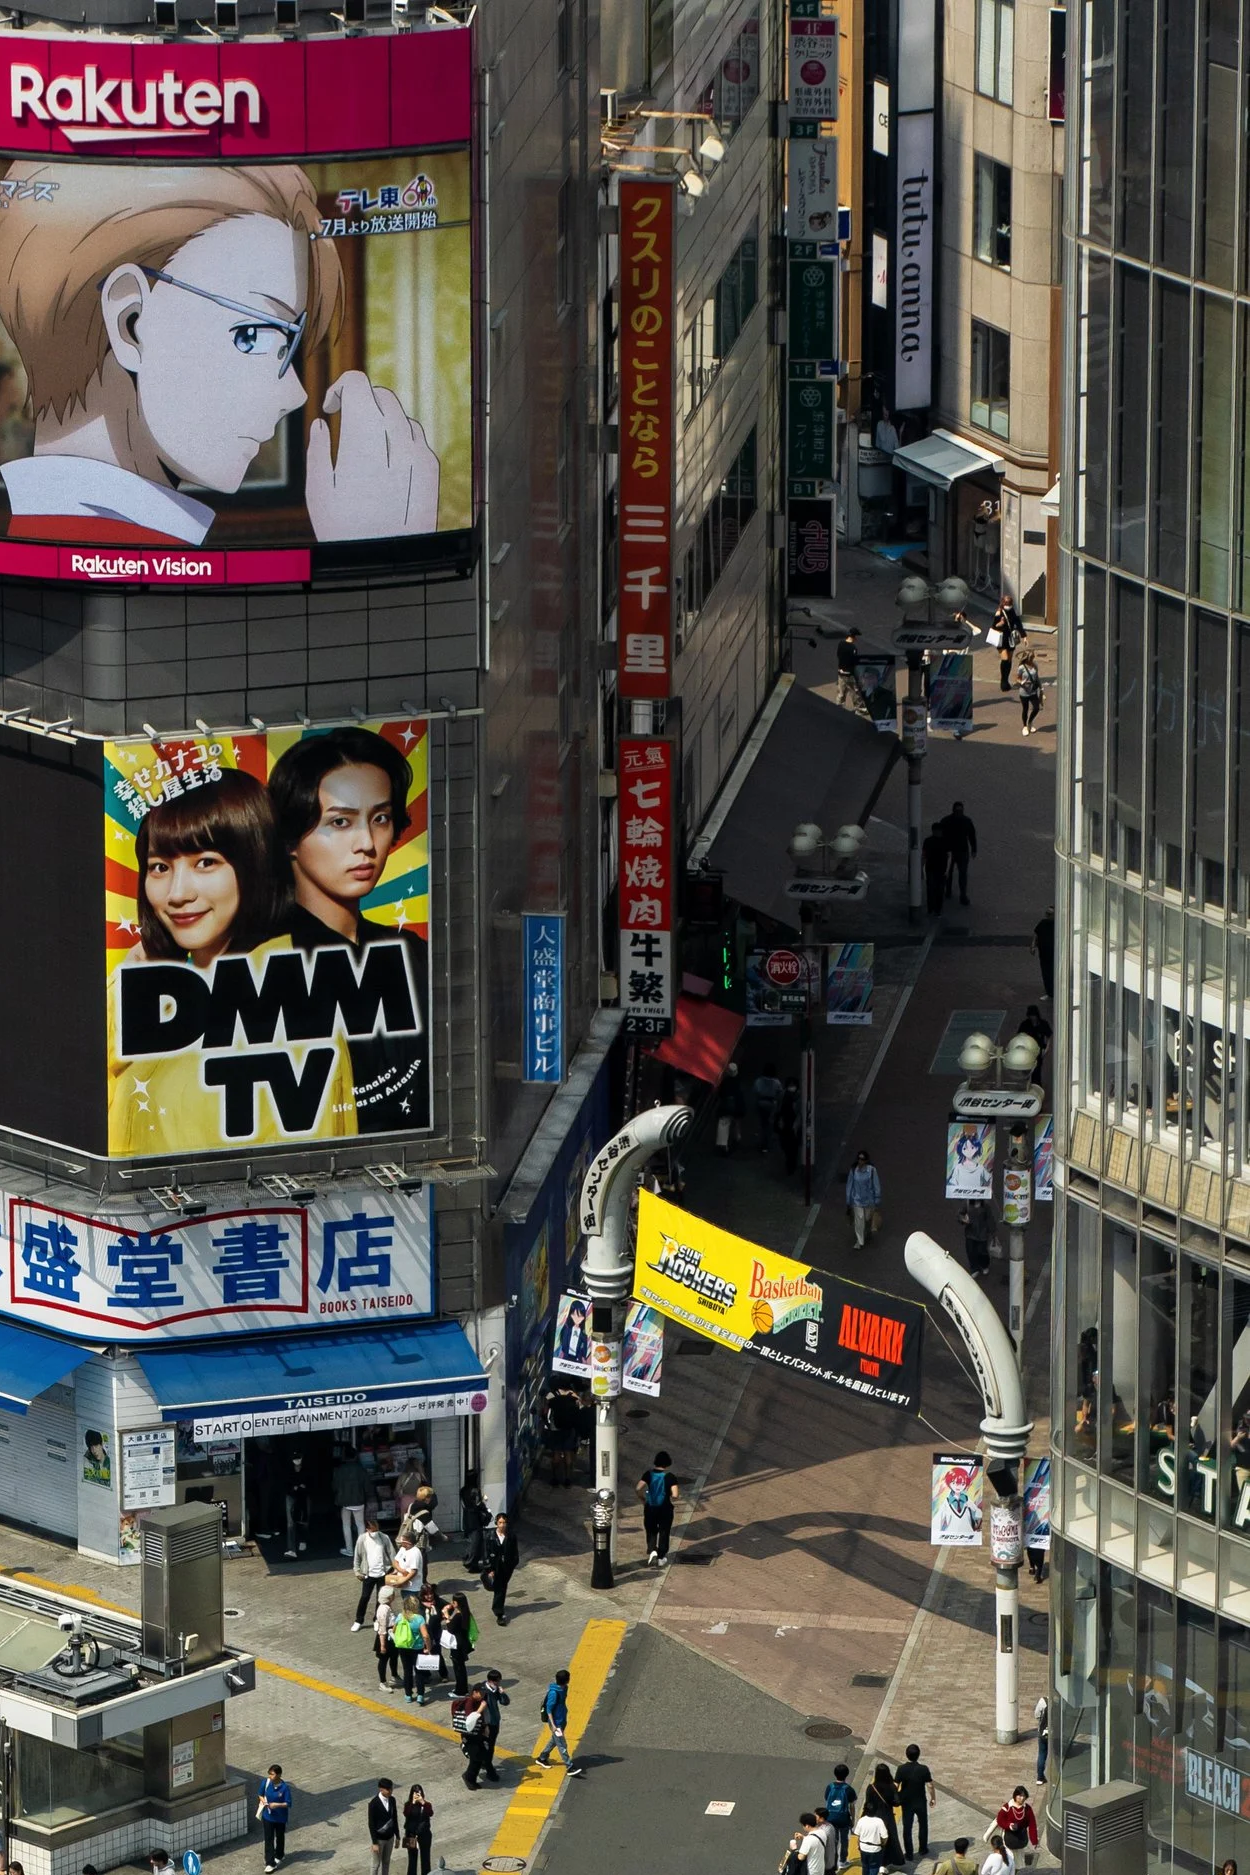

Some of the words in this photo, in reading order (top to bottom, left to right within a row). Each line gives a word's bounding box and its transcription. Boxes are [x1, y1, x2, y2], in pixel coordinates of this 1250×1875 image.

[804, 22, 822, 35] 4F
[794, 49, 833, 60] クリニック
[11, 63, 261, 126] Rakuten
[796, 125, 815, 136] 3F
[337, 187, 400, 214] テレ東
[320, 211, 438, 236] 7月より放送開始
[794, 244, 814, 256] 2F
[628, 196, 663, 479] クスリのことなら
[795, 364, 813, 376] 1F
[793, 483, 812, 495] B1
[71, 553, 149, 577] Rakuten
[151, 557, 212, 577] Vision
[622, 503, 668, 675] 三千里
[623, 746, 665, 768] 元氣
[113, 743, 223, 801] 幸せカナコの
[126, 758, 223, 821] 殺し屋生活
[628, 932, 665, 1005] 牛繁
[770, 961, 798, 975] 消火栓
[120, 943, 417, 1056] DMM
[532, 924, 559, 1076] 大盛堂商事ビル
[205, 1051, 335, 1138] TV
[332, 1099, 354, 1114] Life
[368, 1090, 382, 1103] an
[383, 1058, 422, 1098] Assassin
[351, 1066, 398, 1097] Kanako's
[583, 1133, 631, 1231] 渋谷センター街
[677, 1244, 703, 1265] SUN
[646, 1232, 737, 1308] ROCKERS
[749, 1259, 823, 1302] Basketball
[319, 1297, 357, 1314] BOOKS
[361, 1293, 414, 1310] TAISEIDO
[697, 1296, 725, 1316] SHIBUYA
[838, 1304, 906, 1366] ALVARK
[284, 1392, 367, 1409] TAISEIDO
[195, 1419, 252, 1437] STARTO
[254, 1409, 350, 1429] ENTERTAINMENT
[1188, 1752, 1241, 1814] BLEACH
